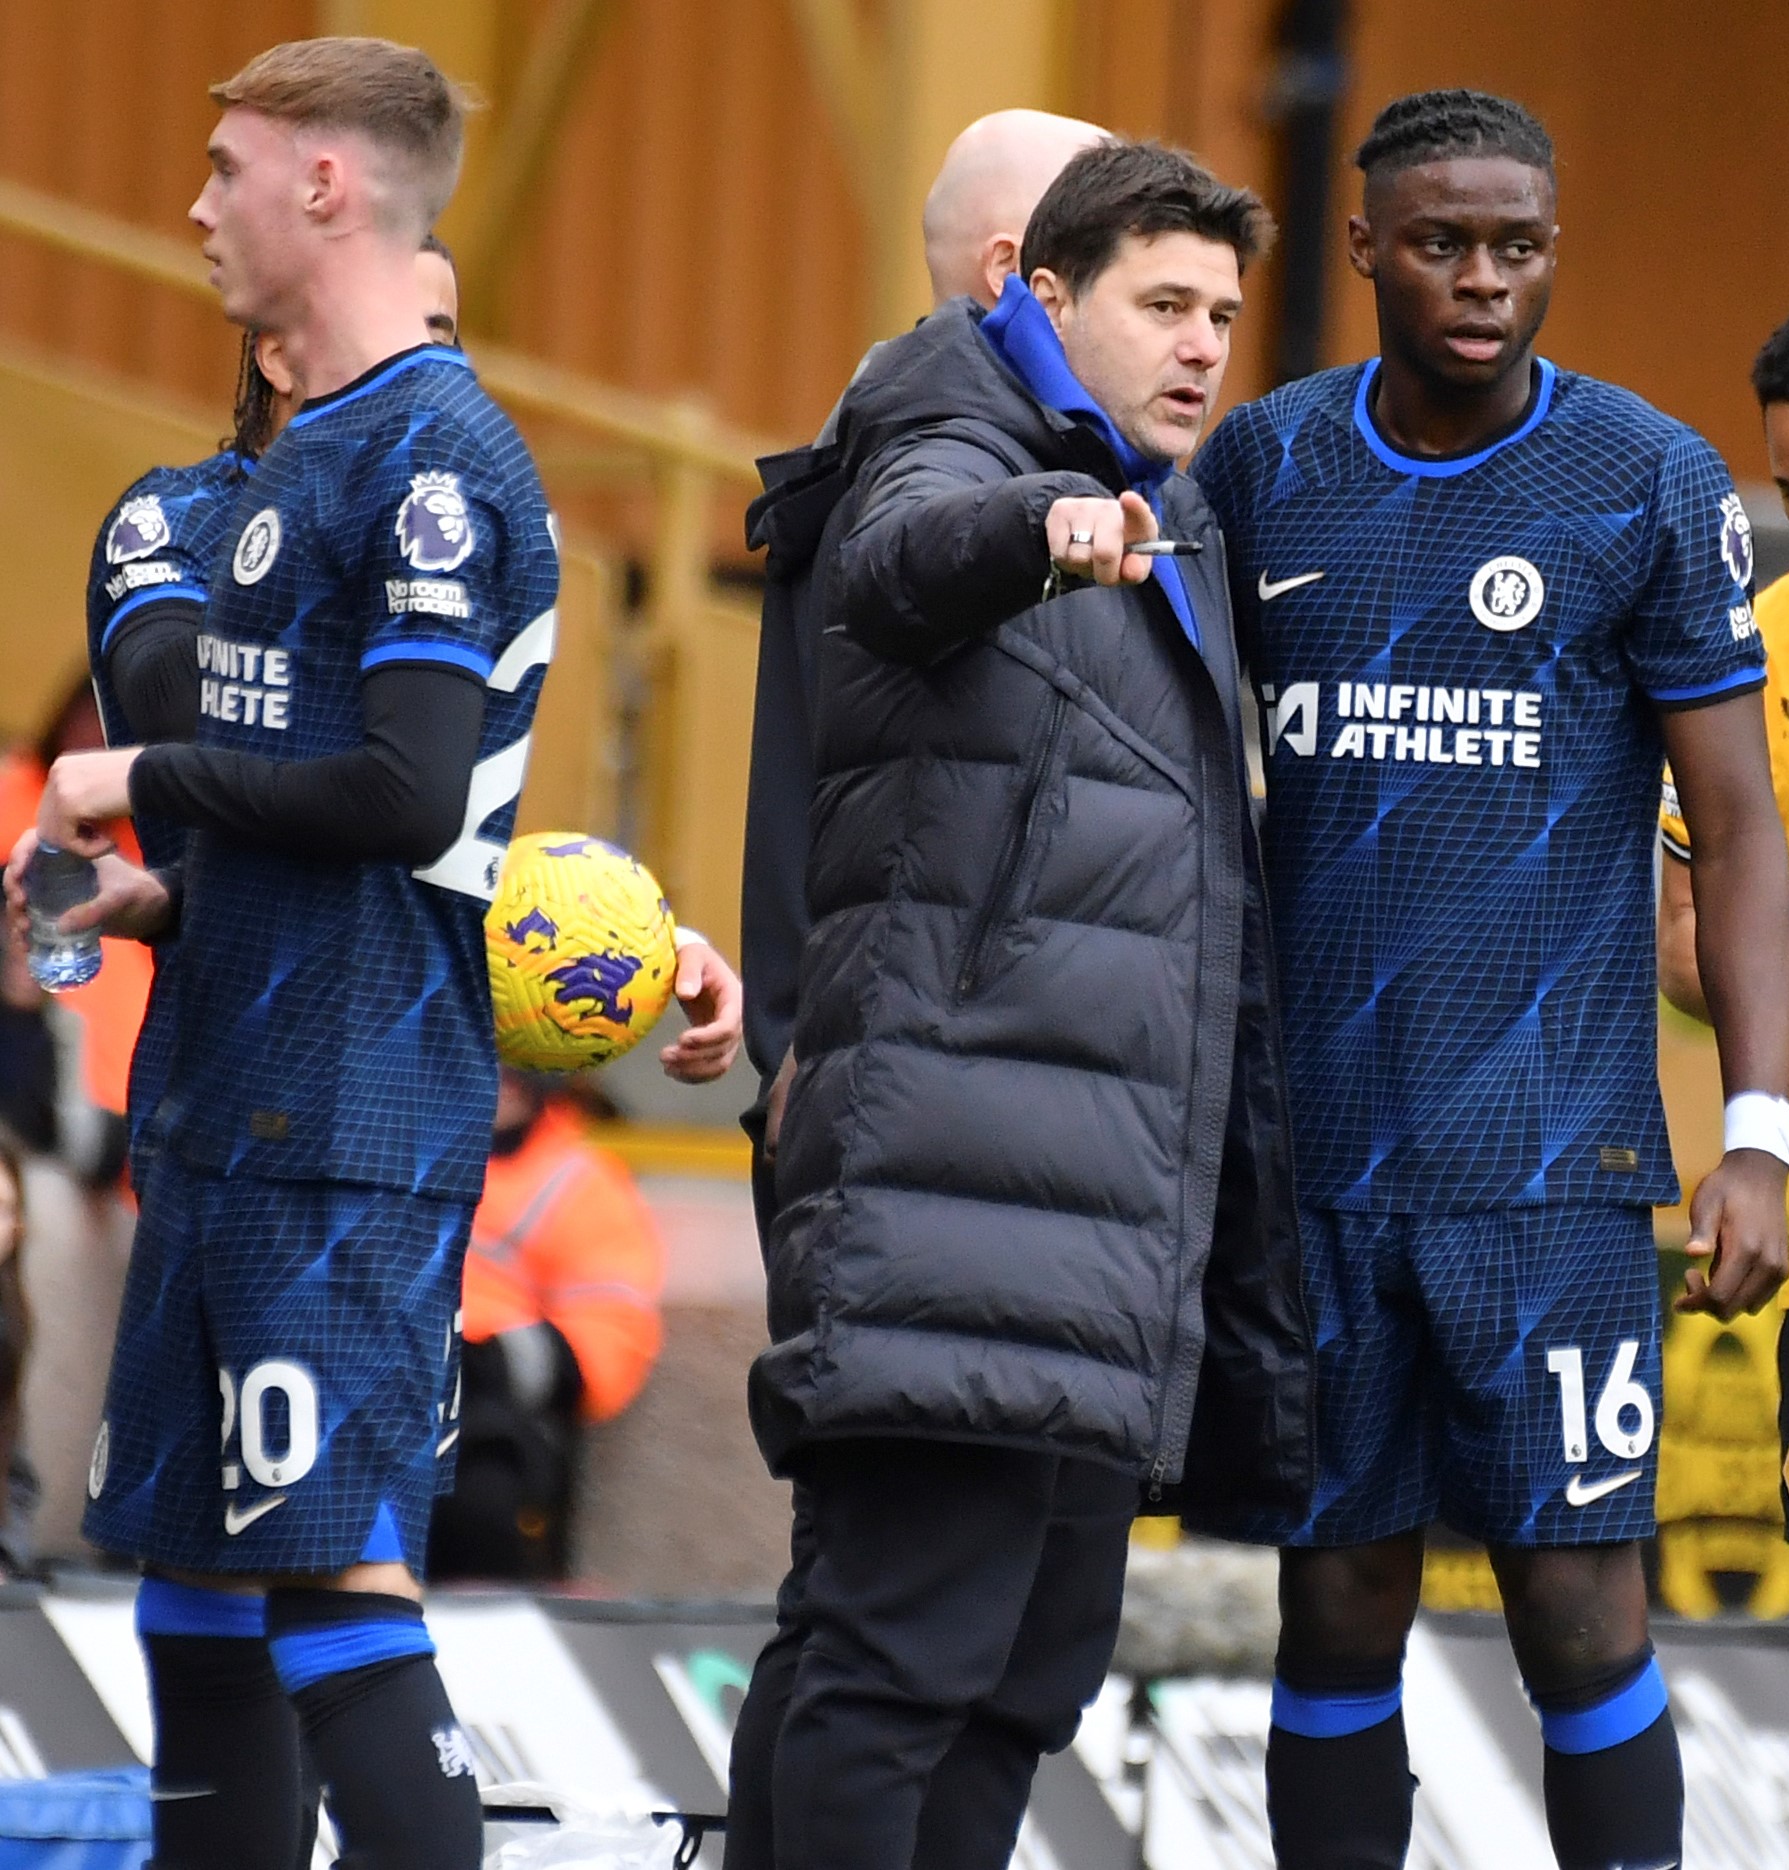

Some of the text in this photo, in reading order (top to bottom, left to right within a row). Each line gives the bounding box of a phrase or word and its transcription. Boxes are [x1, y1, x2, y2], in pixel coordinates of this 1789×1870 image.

[384, 580, 464, 600] No room
[1337, 681, 1543, 728] INFINITE
[1330, 723, 1542, 768] ATHLETE
[1547, 1341, 1655, 1462] 16
